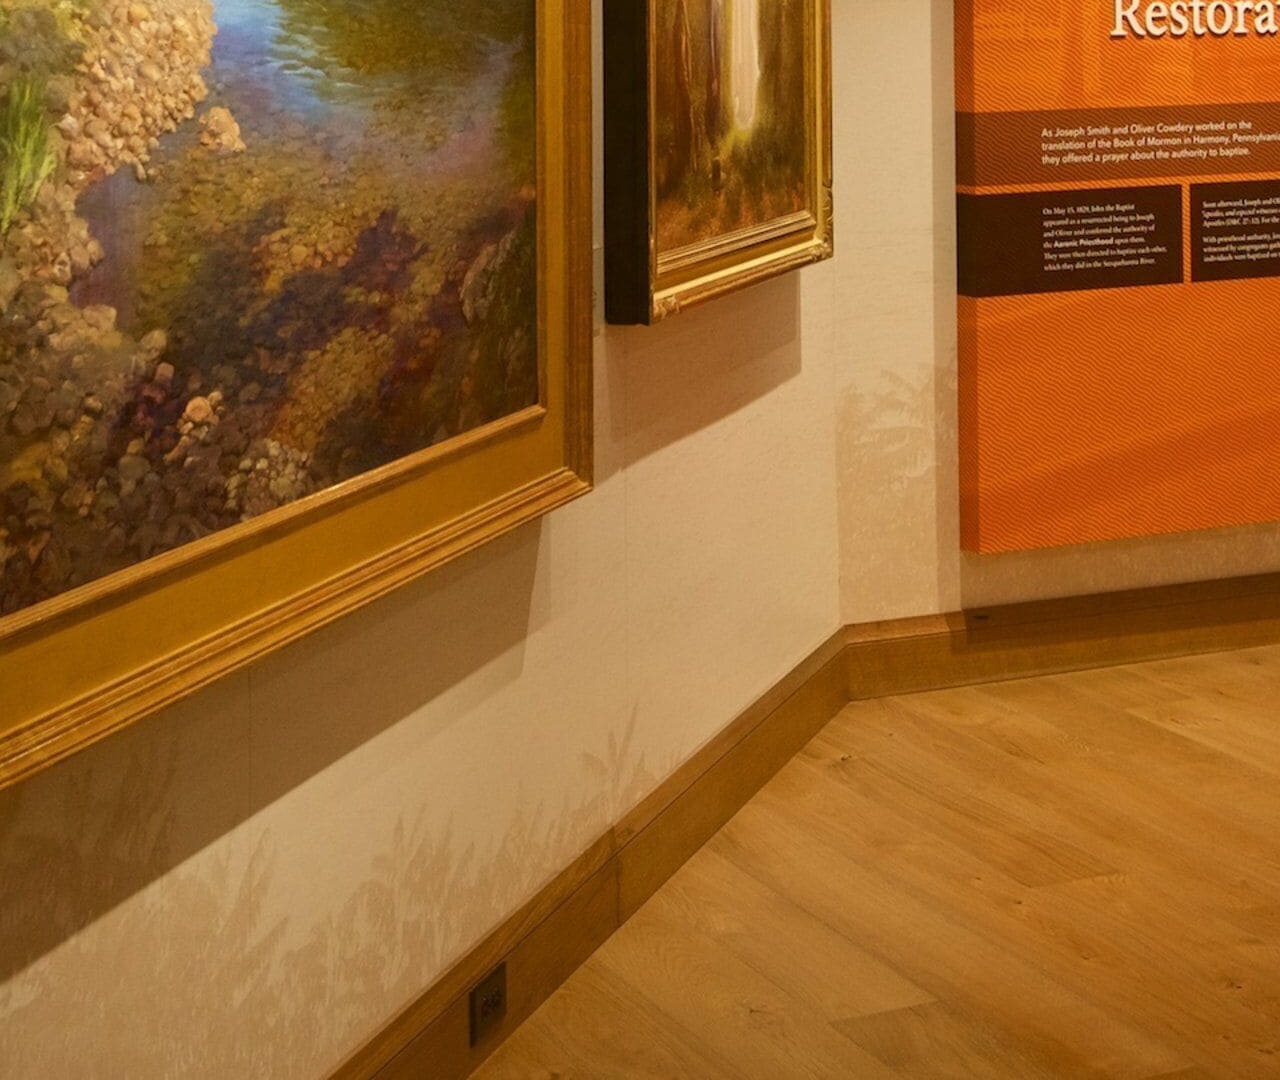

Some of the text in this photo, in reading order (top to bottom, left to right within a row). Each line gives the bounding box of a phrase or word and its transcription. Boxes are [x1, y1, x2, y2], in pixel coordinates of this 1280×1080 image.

[1041, 120, 1252, 139] As Joseph Smith and Oliver Cowdery worked on the
[1041, 140, 1085, 151] translation
[1087, 138, 1096, 149] of
[1097, 138, 1112, 148] the
[1113, 137, 1135, 148] Book
[1136, 136, 1146, 146] of
[1147, 136, 1182, 146] Mormon
[1041, 153, 1060, 166] they
[1061, 152, 1094, 163] offered
[1094, 154, 1100, 162] a
[1101, 152, 1129, 164] prayer
[1130, 150, 1155, 161] about
[1156, 149, 1170, 159] the
[1171, 148, 1208, 160] authority
[1208, 148, 1218, 157] to
